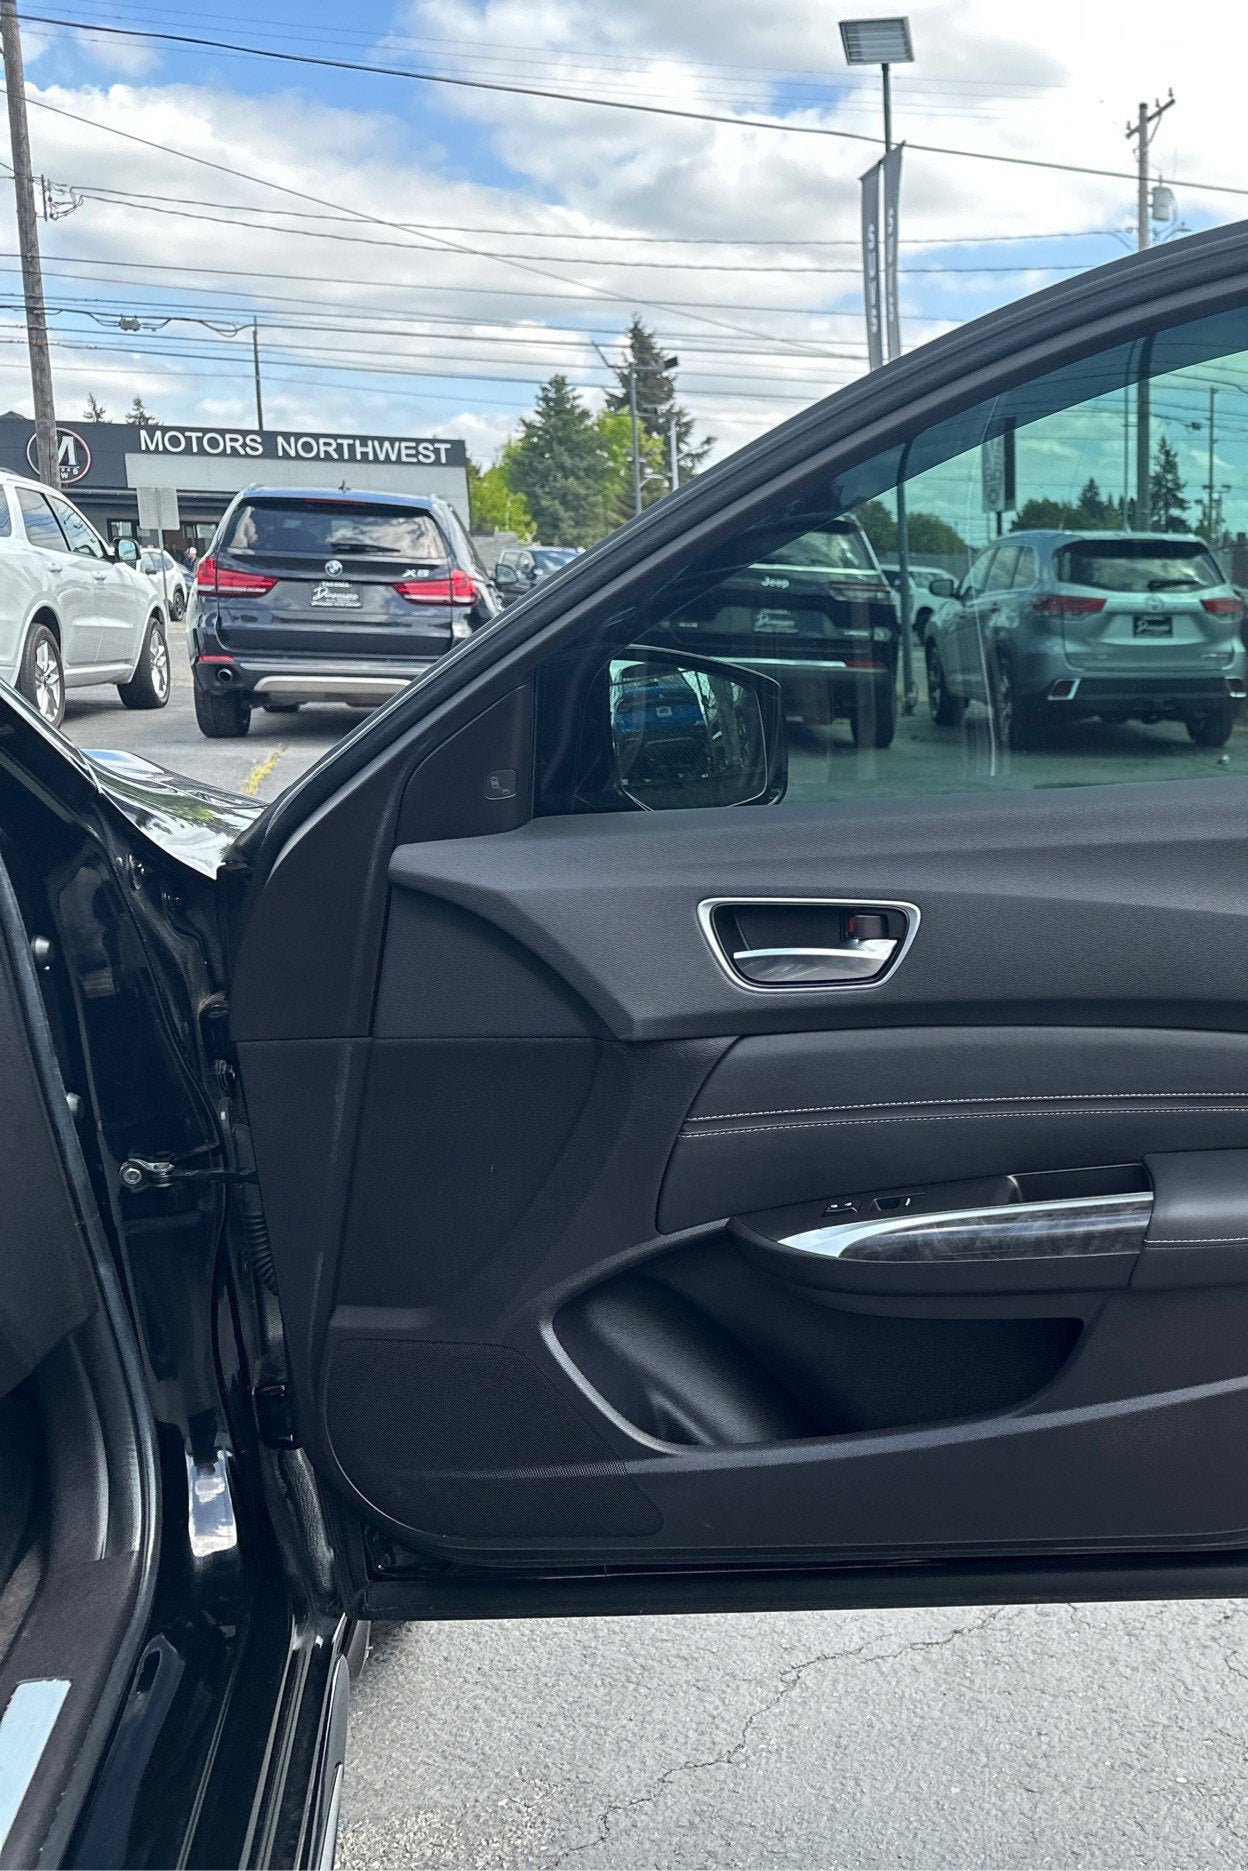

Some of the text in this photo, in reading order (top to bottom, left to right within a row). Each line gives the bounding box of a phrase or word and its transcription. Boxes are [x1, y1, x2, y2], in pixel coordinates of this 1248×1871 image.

[139, 429, 452, 464] MOTORS NORTHWEST
[761, 577, 789, 589] Jeep
